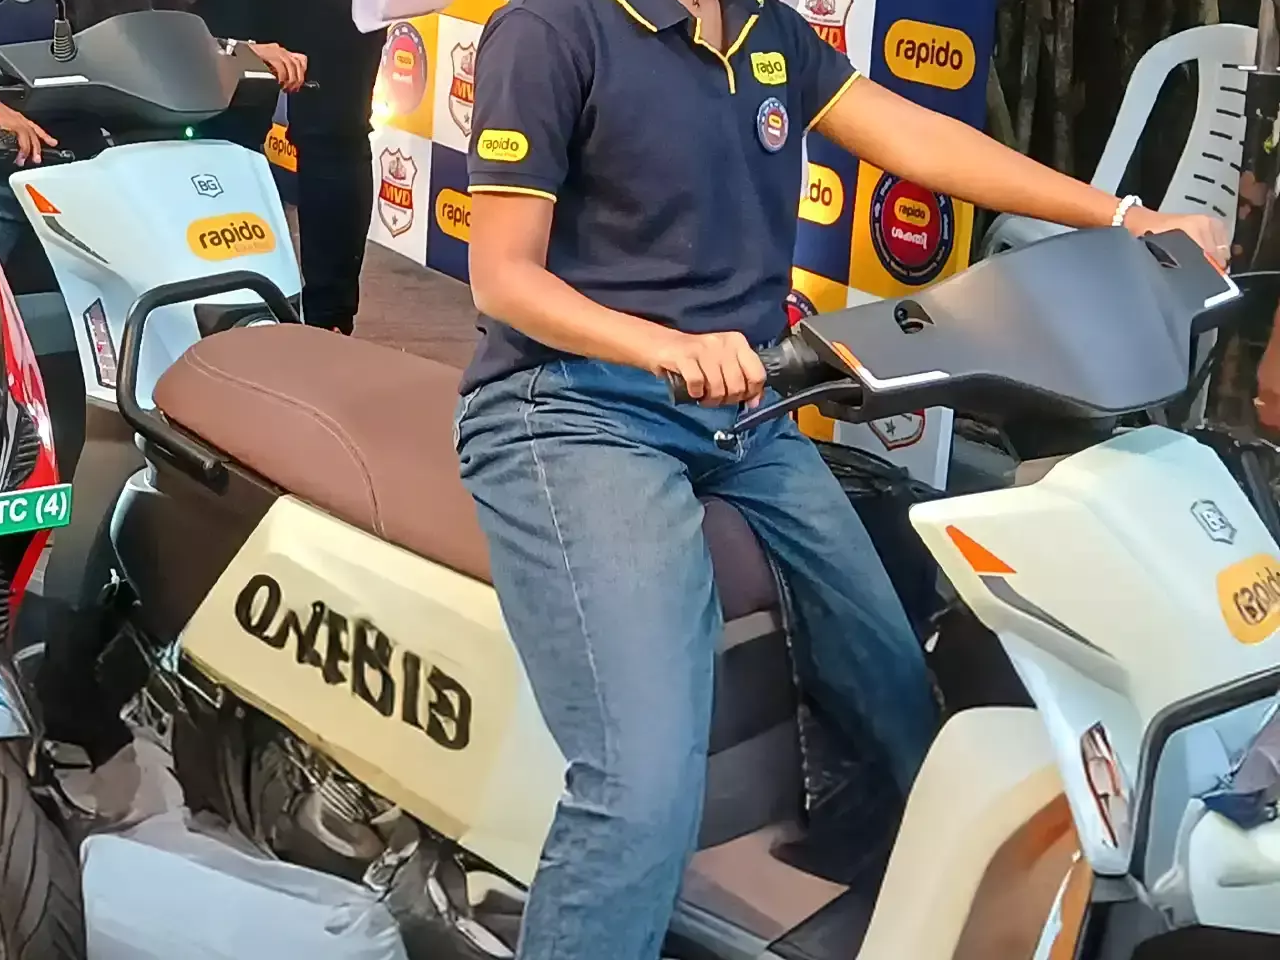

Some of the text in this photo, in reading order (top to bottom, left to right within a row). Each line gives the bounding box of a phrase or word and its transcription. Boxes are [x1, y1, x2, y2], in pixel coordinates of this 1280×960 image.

[811, 25, 841, 48] VD
[895, 38, 963, 71] rapido
[456, 79, 474, 103] MV
[482, 138, 519, 152] rapido
[197, 179, 218, 191] BG
[382, 182, 411, 207] MVD
[442, 203, 471, 227] rapi
[898, 204, 926, 219] rapido
[199, 220, 266, 249] rapido
[35, 491, 68, 524] (4)
